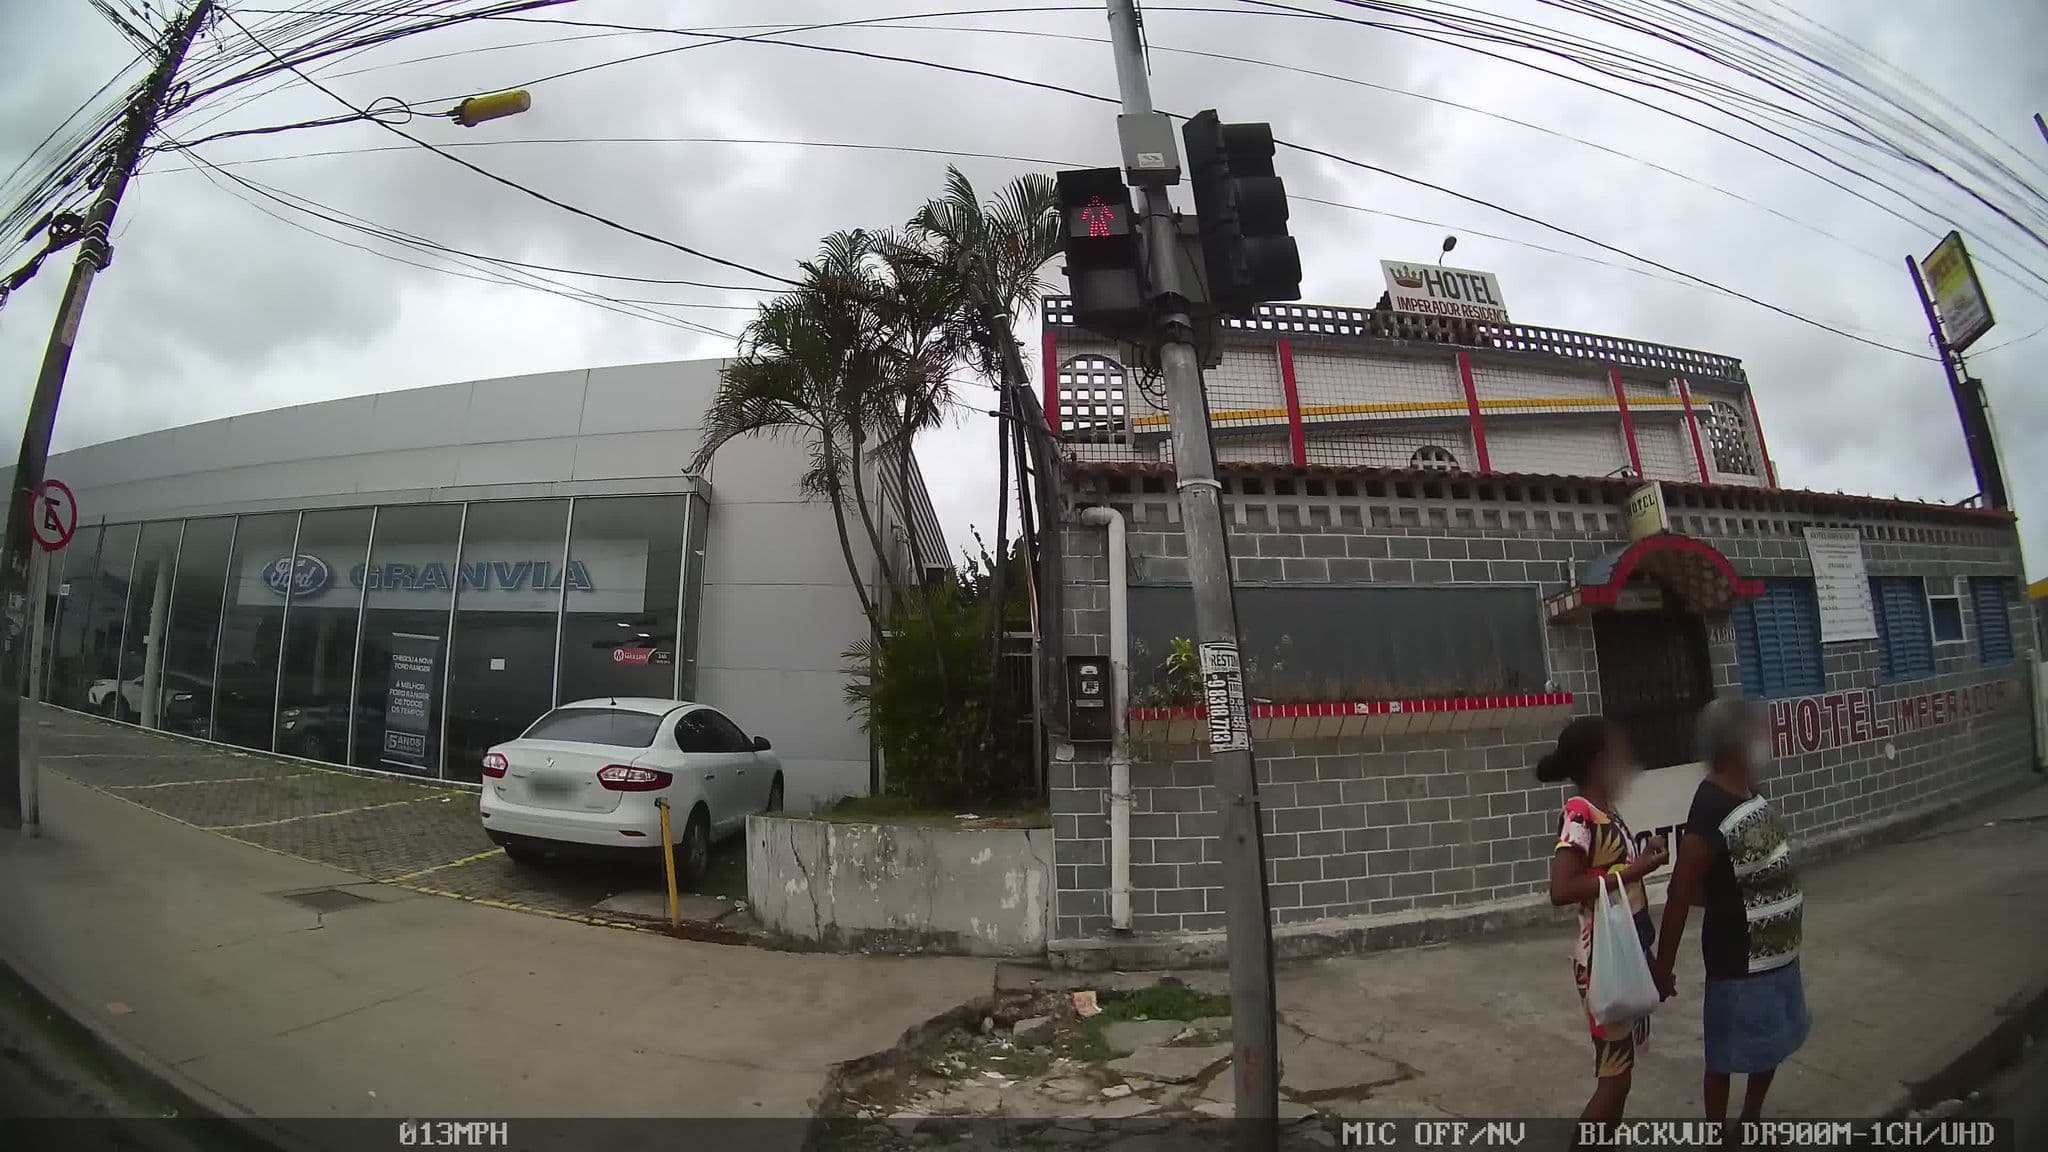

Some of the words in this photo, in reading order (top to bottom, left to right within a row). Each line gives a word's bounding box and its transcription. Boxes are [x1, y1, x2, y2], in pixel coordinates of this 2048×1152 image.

[1422, 268, 1499, 306] HOTEL
[1396, 296, 1461, 317] IMPERADOR
[1626, 493, 1656, 517] HOTEL
[270, 555, 318, 589] Ford
[351, 560, 593, 590] GRANVIA
[1767, 688, 1893, 760] HOTEL
[389, 734, 398, 749] 5
[397, 735, 422, 747] ANOS
